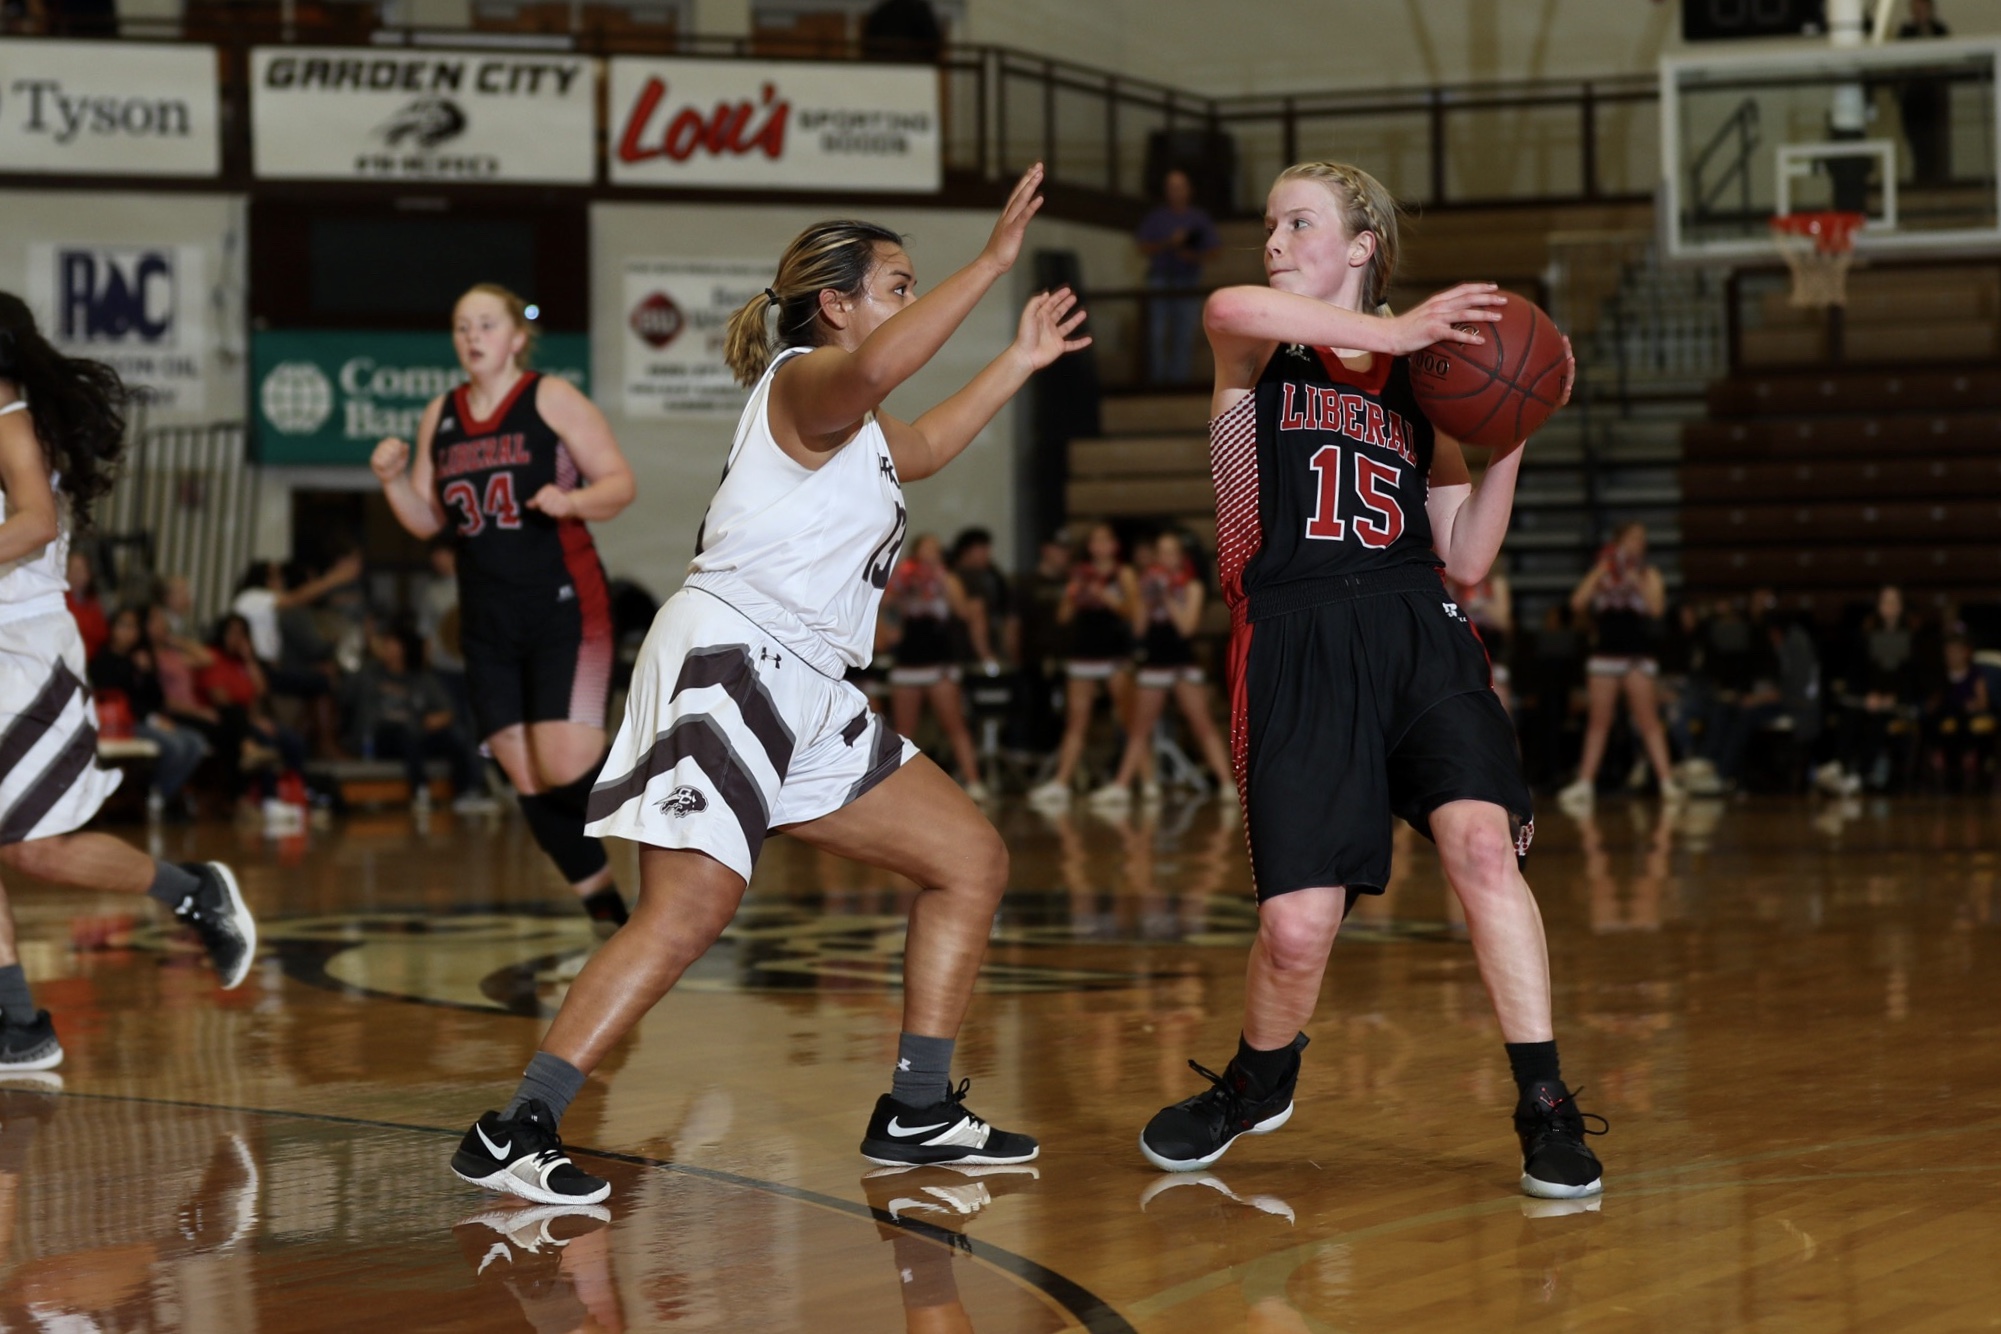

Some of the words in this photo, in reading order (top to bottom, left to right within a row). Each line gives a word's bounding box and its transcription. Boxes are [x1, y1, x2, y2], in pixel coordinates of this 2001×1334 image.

[266, 57, 464, 92] GARDEN
[475, 62, 583, 96] CITY
[11, 79, 190, 146] Tyson
[438, 432, 531, 477] LIBERAL
[1280, 382, 1418, 468] LIBERAL
[443, 471, 523, 538] 34
[1305, 444, 1405, 550] 15
